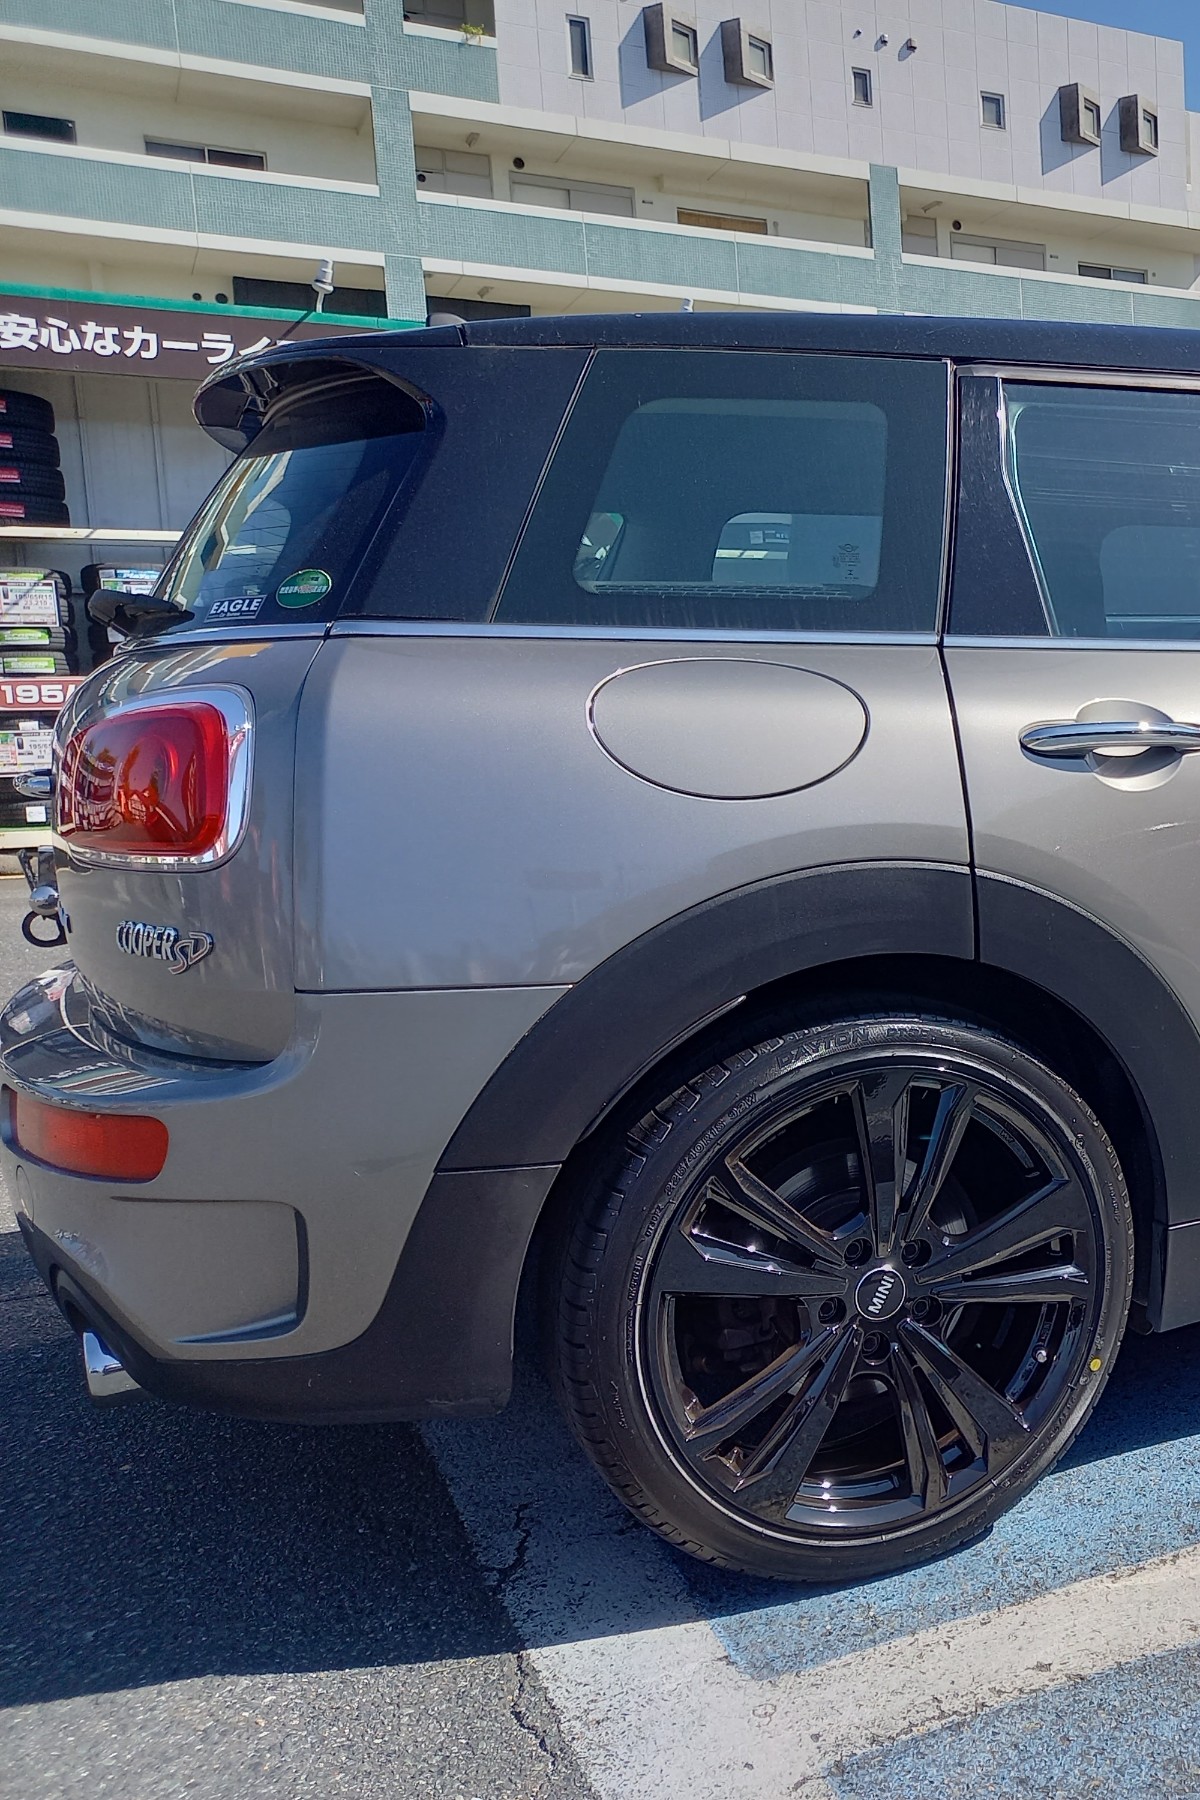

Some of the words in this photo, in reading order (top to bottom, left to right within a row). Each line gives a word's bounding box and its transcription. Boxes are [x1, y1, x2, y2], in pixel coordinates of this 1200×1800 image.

[0, 312, 298, 365] 安心なカーライ
[210, 598, 262, 615] EAGLE
[116, 920, 179, 961] COOPER
[867, 1275, 895, 1314] MINI
